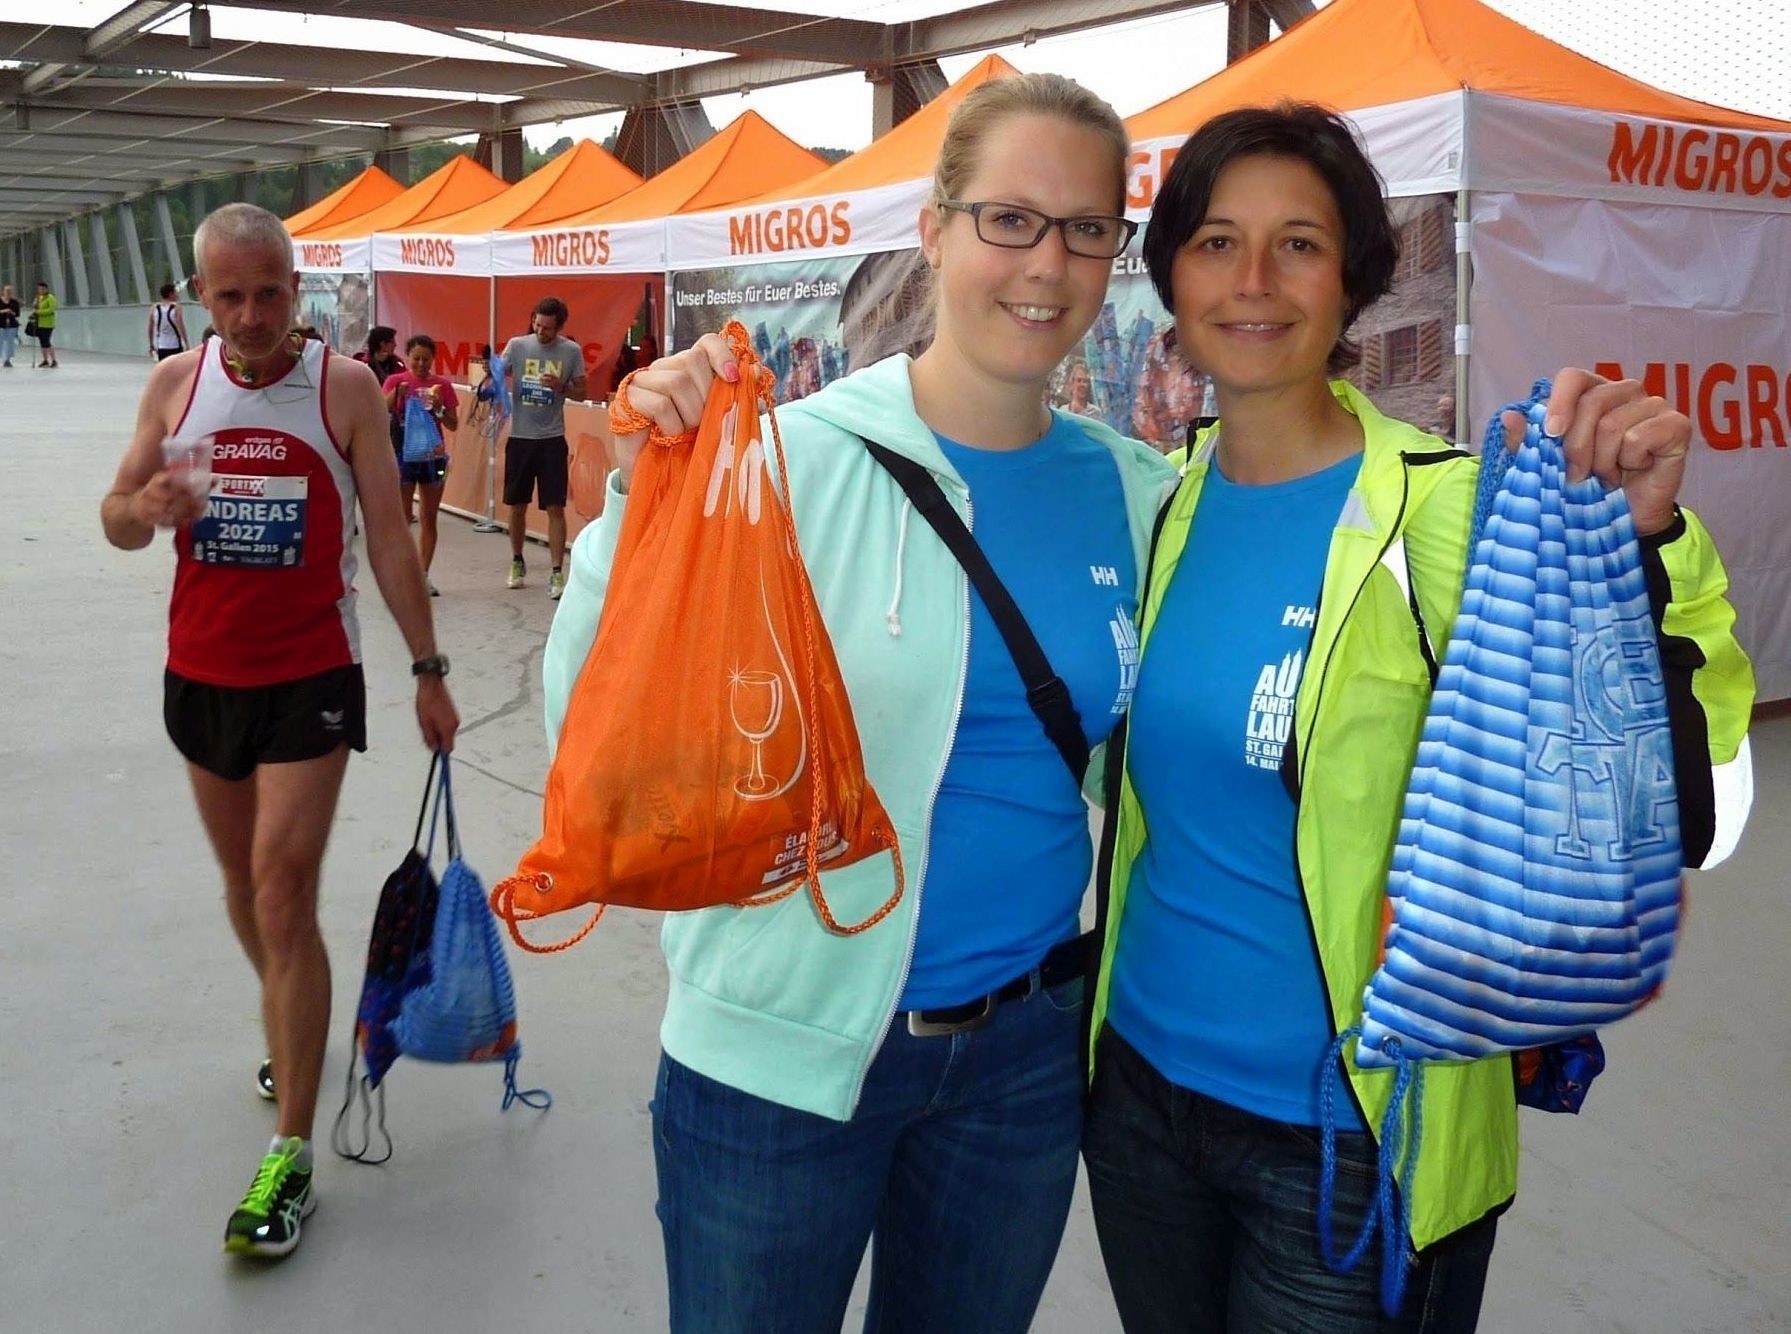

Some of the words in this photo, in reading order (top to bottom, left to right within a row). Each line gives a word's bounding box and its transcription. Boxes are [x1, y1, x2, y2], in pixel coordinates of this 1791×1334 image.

[729, 201, 852, 256] MIGROS
[302, 244, 342, 267] MIGROS
[400, 238, 456, 267] MIGROS
[531, 230, 611, 267] MIGROS
[676, 290, 706, 307] Unser
[707, 289, 743, 306] Bestes
[745, 286, 761, 304] für
[765, 284, 791, 301] Euer
[794, 280, 841, 300] Bestes.
[212, 444, 287, 460] GRAVAG
[206, 500, 299, 521] NDREAS
[218, 523, 266, 541] 2027
[220, 541, 252, 552] Gallen
[253, 543, 279, 553] 2015
[1089, 565, 1119, 586] HH
[1281, 605, 1316, 629] HH
[1245, 740, 1261, 754] ST.
[774, 846, 806, 866] CHEZ
